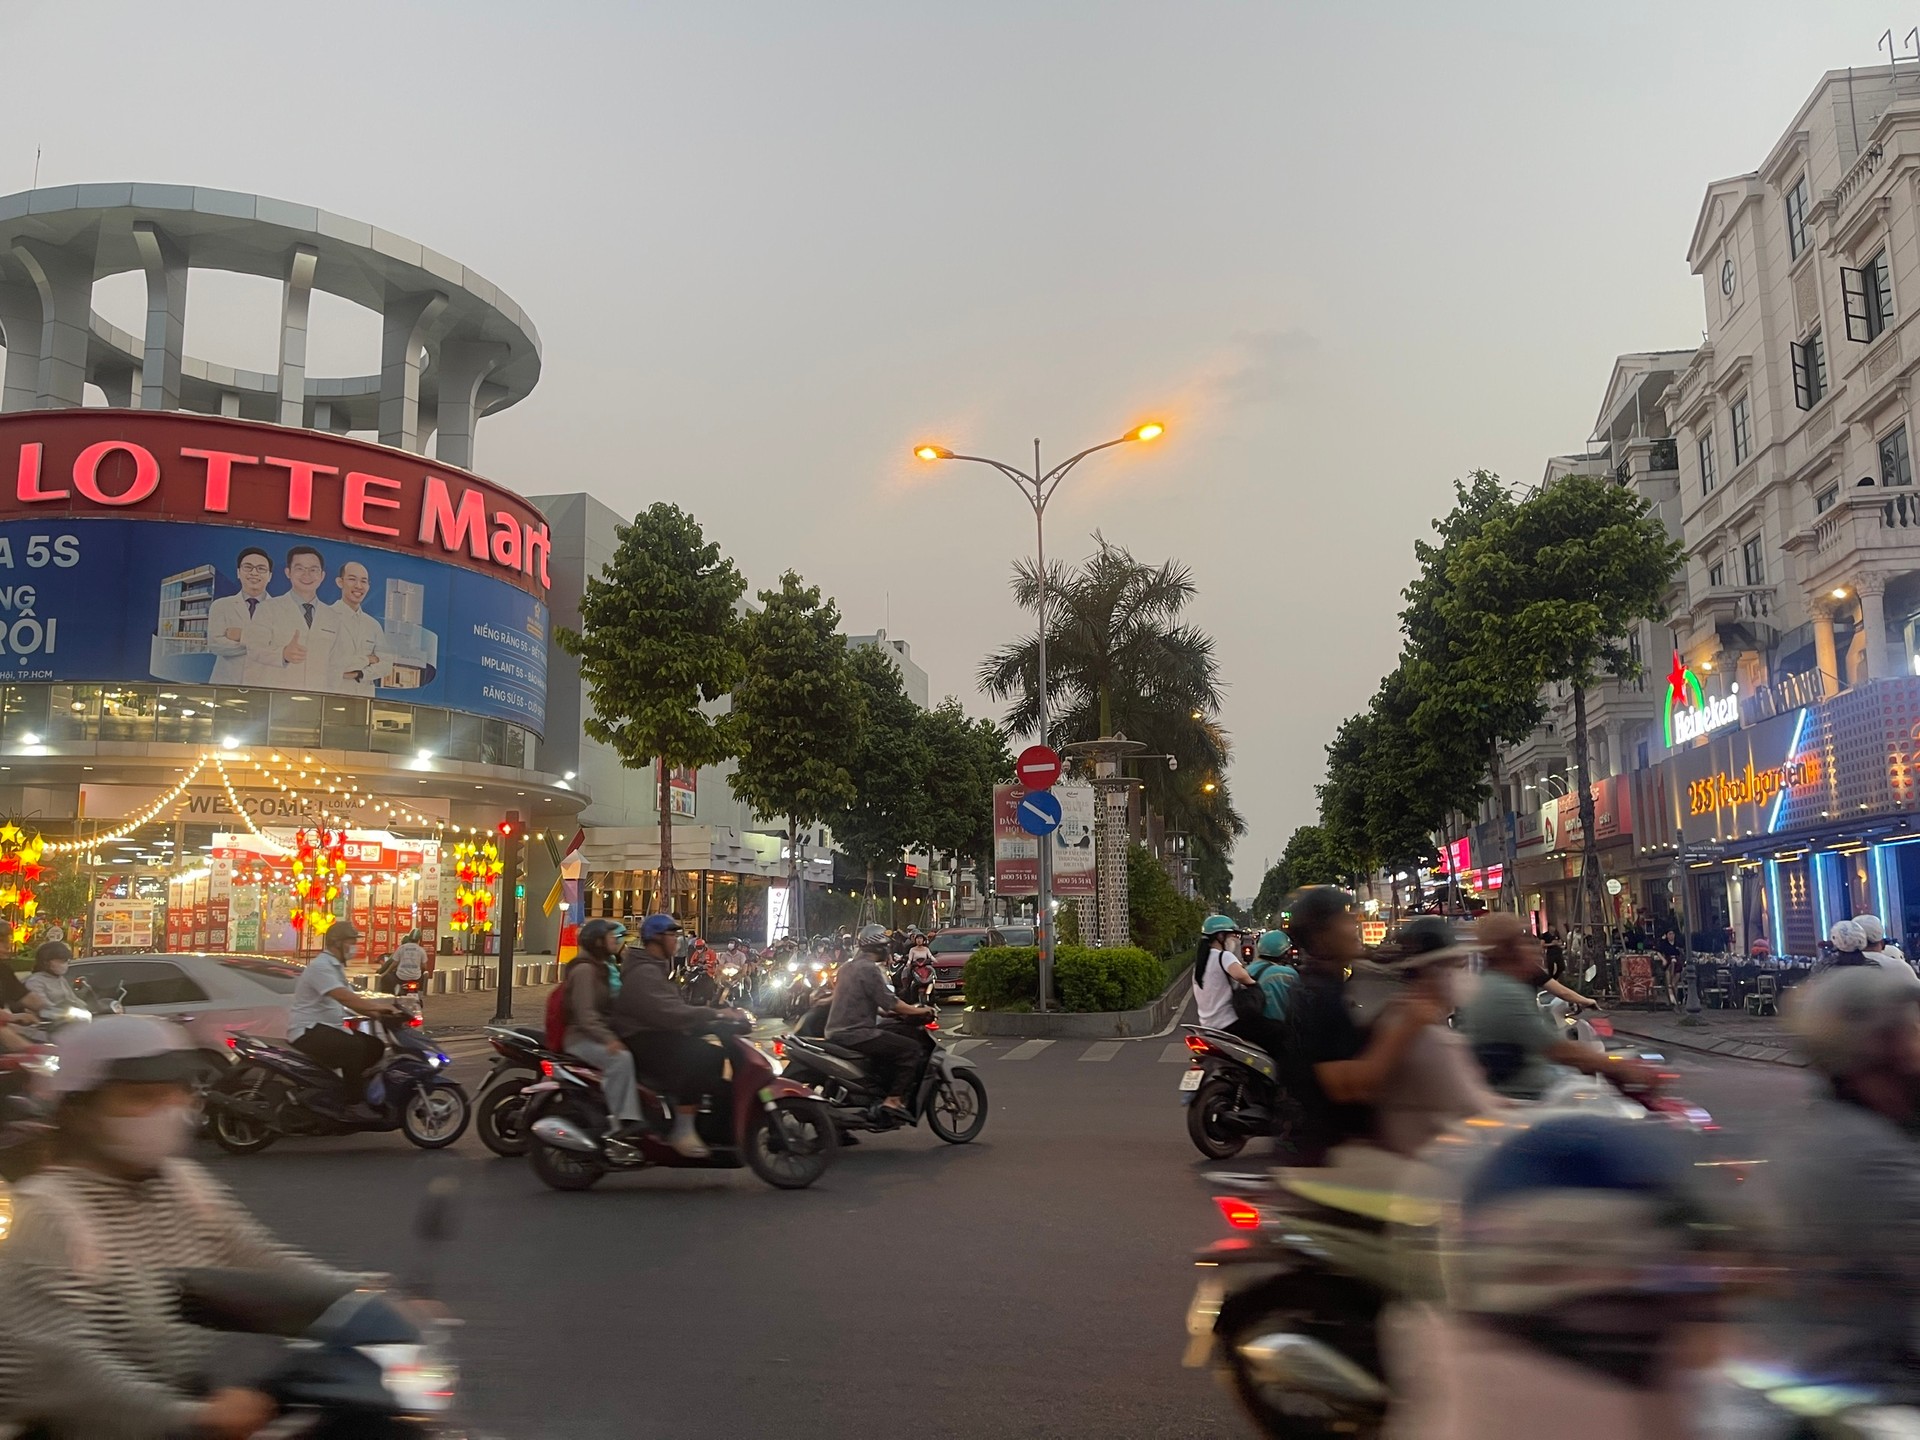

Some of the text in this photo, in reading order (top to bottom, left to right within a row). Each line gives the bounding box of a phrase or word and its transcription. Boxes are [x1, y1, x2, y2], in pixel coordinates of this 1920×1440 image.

[17, 440, 551, 590] LOTTE Mart
[26, 535, 80, 568] 5S
[17, 670, 53, 679] TP.HCM
[481, 655, 515, 676] IMPLANT
[1674, 682, 1740, 744] Heineken
[1687, 776, 1716, 816] 255
